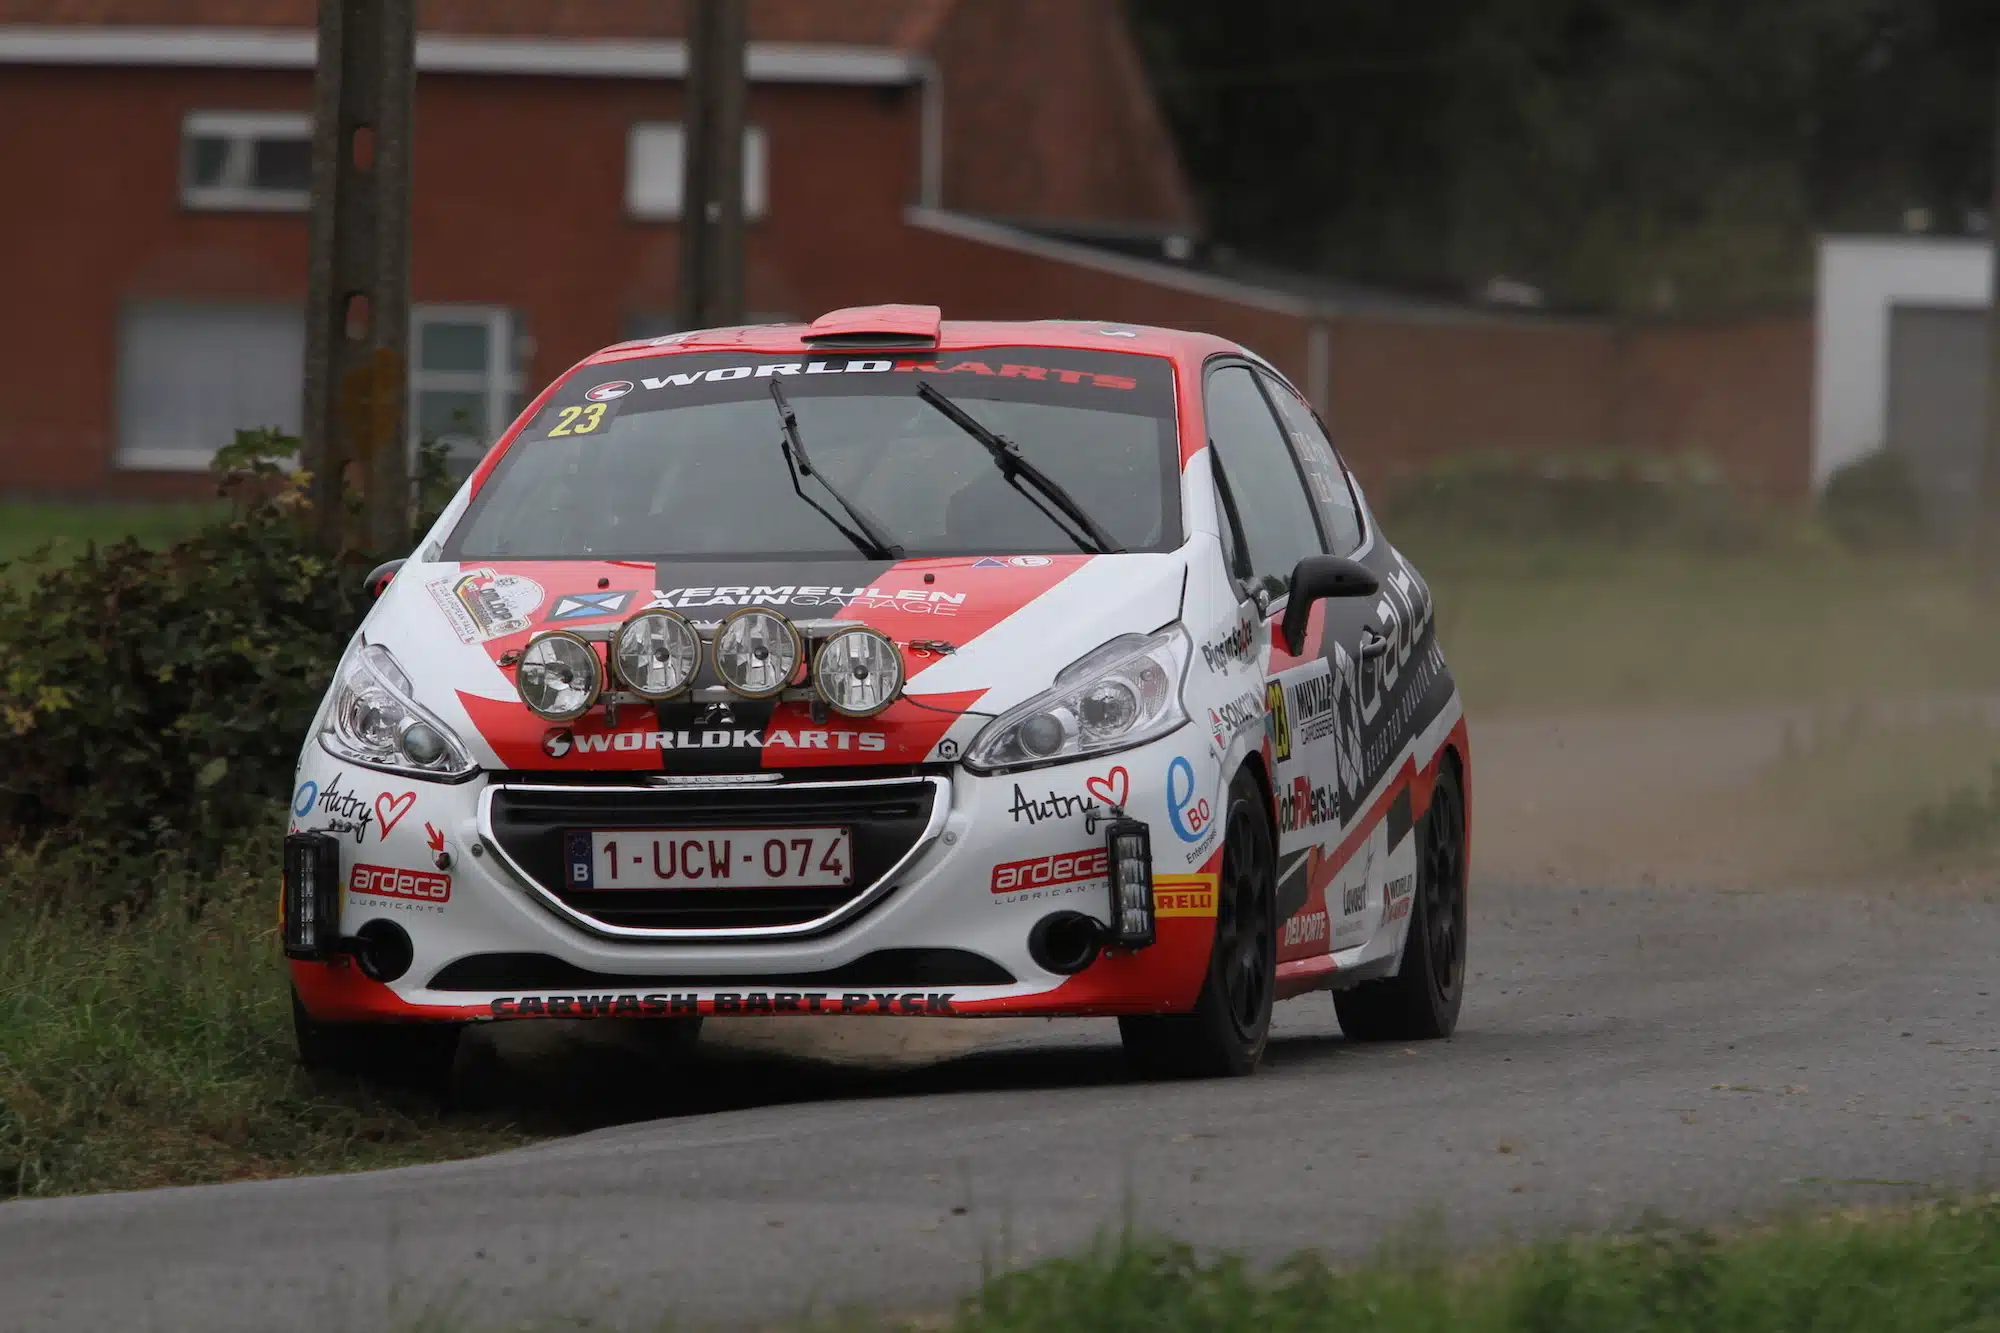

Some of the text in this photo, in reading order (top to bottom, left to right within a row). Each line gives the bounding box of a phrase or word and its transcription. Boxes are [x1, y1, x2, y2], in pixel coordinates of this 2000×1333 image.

[640, 359, 1137, 390] WORLDKARTS
[548, 402, 606, 438] 23
[650, 586, 967, 604] VERMEULEN
[1295, 673, 1333, 721] MUYLLE
[574, 729, 887, 752] WORLDKARTS
[318, 772, 373, 844] Autry
[1008, 783, 1100, 835] Autry
[1187, 797, 1211, 833] BO
[573, 836, 844, 882] B 1-UCW-074
[353, 867, 449, 899] ardeca
[1155, 889, 1212, 909] RELLI
[350, 899, 445, 914] LUBRICANTS
[1284, 911, 1327, 947] DELPORTE
[491, 992, 958, 1017] CARWASH BART PYCK
